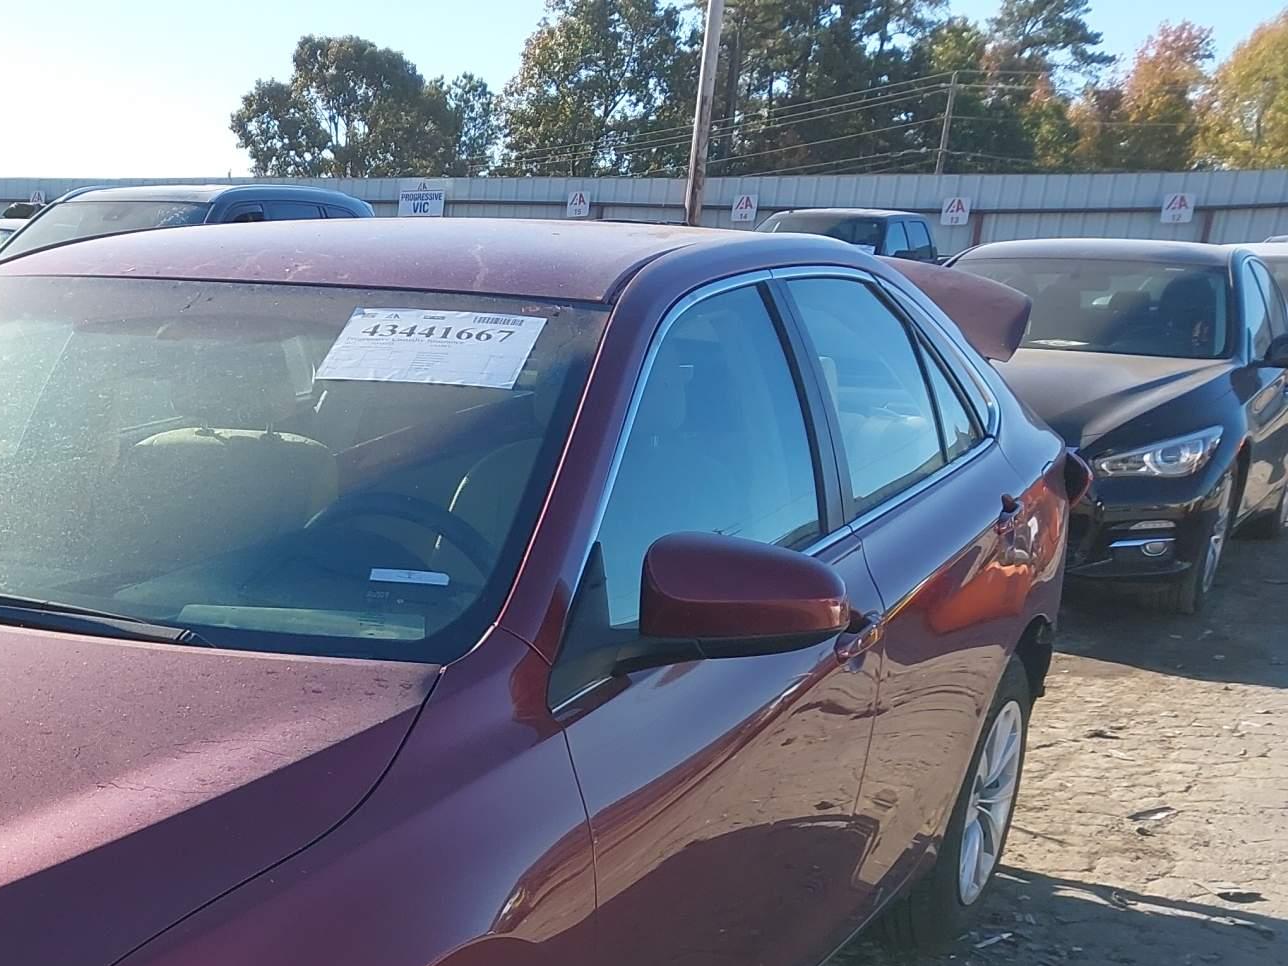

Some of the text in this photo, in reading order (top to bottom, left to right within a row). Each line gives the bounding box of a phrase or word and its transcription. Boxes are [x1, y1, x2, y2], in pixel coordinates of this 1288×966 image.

[401, 192, 443, 201] PROGRESSIVE
[412, 201, 429, 214] VIC
[361, 323, 515, 343] 43441667
